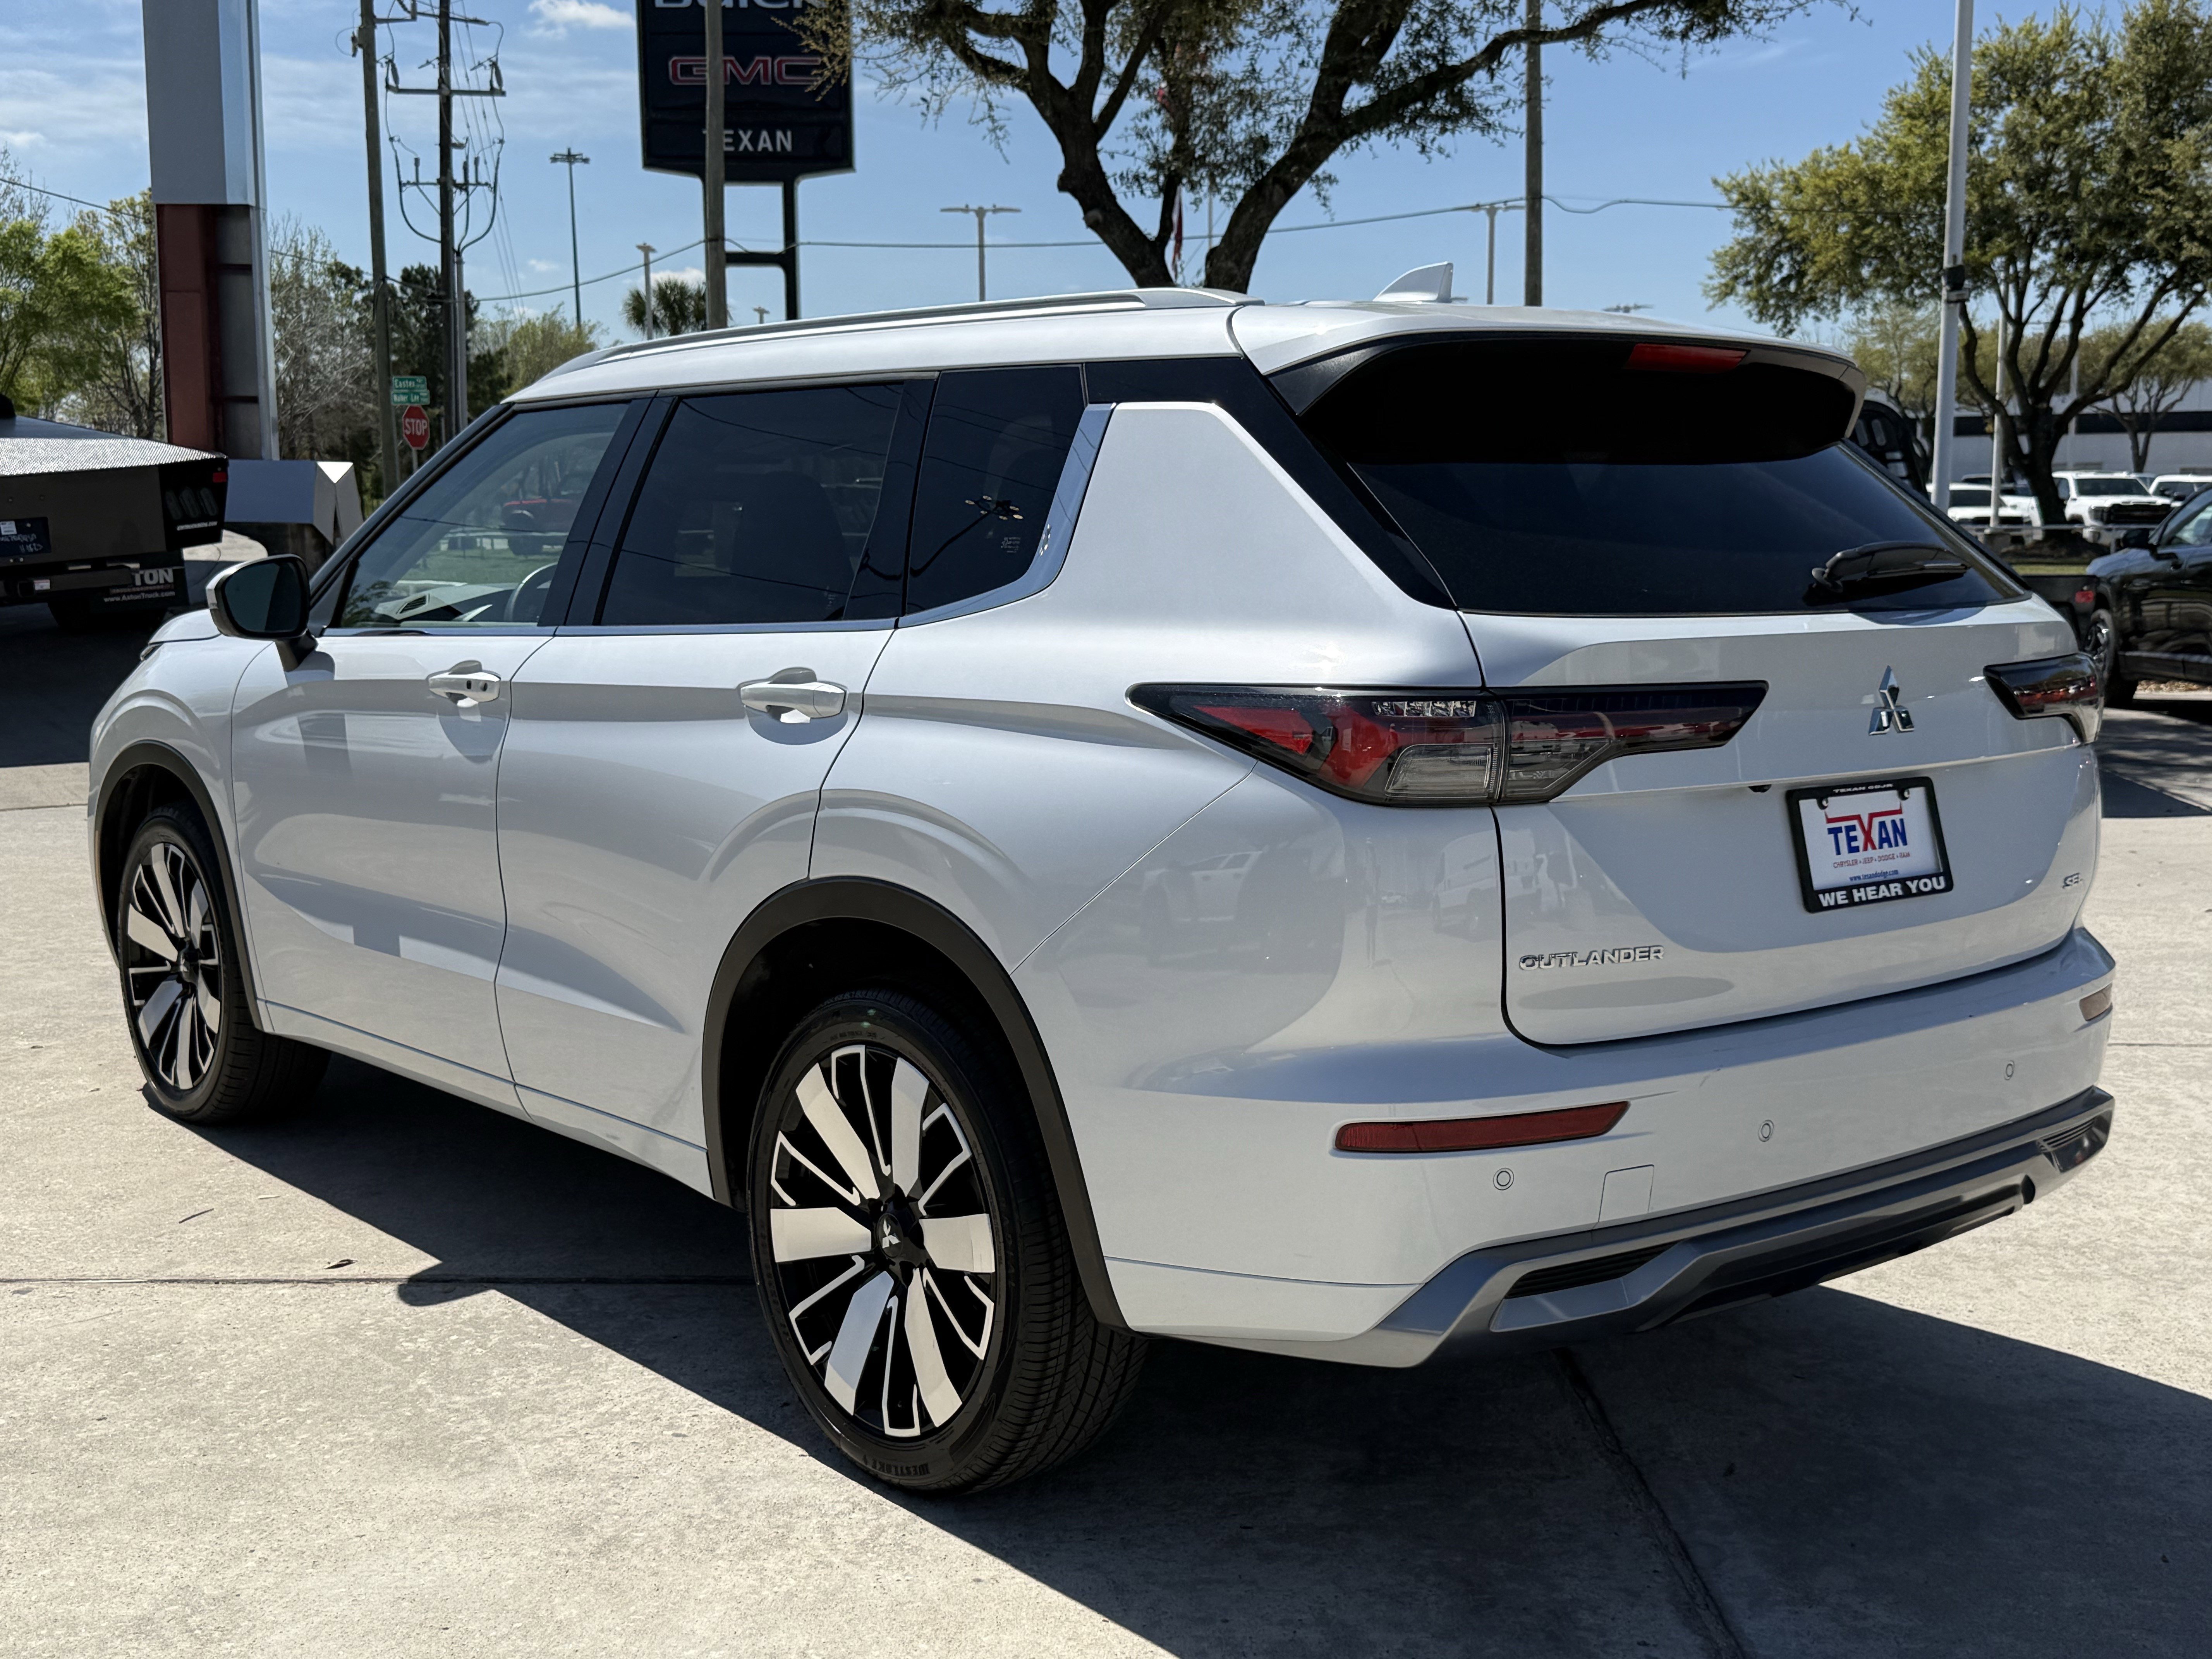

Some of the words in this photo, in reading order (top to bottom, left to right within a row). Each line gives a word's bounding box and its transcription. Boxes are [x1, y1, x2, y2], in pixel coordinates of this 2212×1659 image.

[668, 55, 823, 85] GMC
[405, 418, 428, 436] STOP
[1825, 809, 1908, 855] TEXAN
[1833, 859, 1858, 868] CHRYSLER
[1877, 853, 1896, 862] DODGE
[1819, 891, 1848, 907] WE
[1852, 883, 1903, 902] HEAR
[1906, 876, 1946, 894] YOU
[1519, 945, 1664, 971] OUTLANDER
